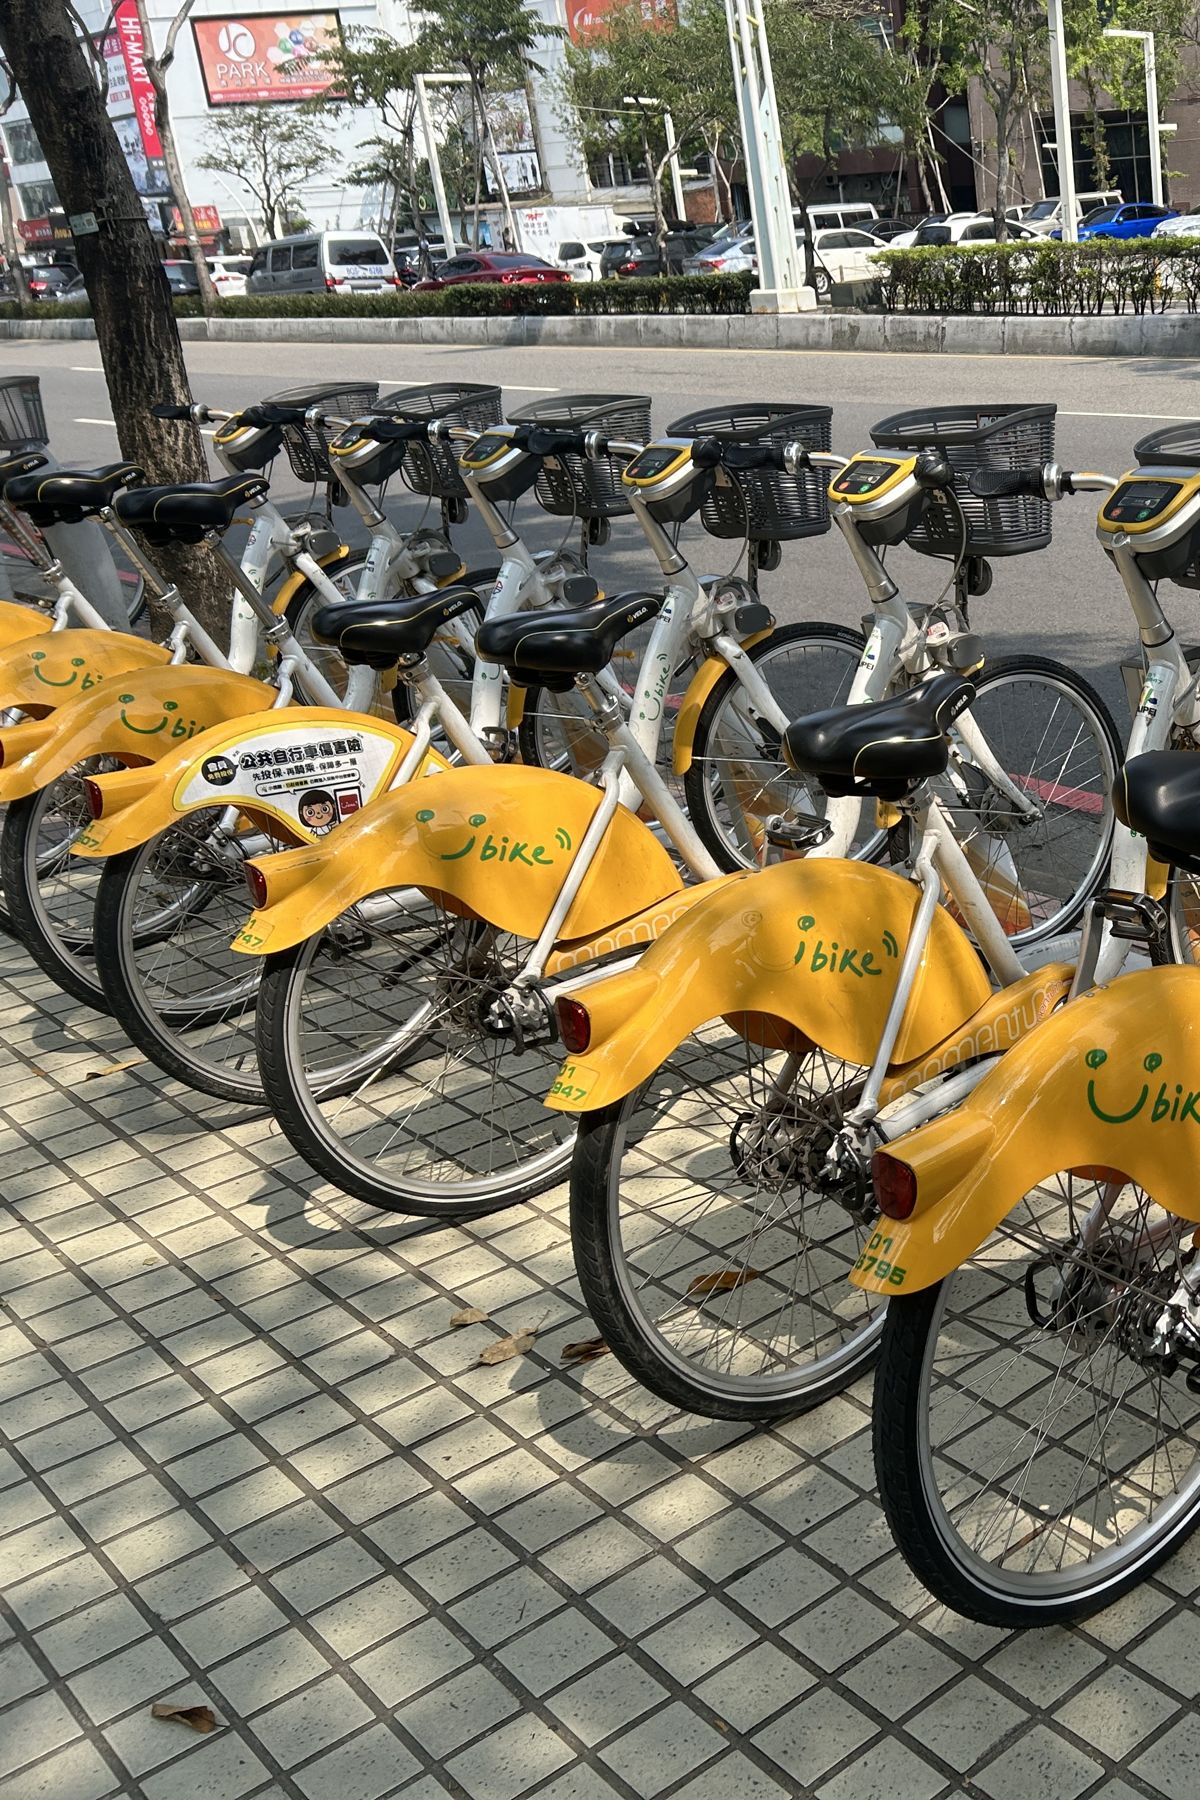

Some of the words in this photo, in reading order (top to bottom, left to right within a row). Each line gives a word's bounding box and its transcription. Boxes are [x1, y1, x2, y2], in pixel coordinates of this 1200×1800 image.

[216, 61, 268, 79] PARK
[630, 606, 649, 621] VELO
[240, 738, 363, 769] 公共自行車傷害險
[869, 1232, 893, 1254] 01
